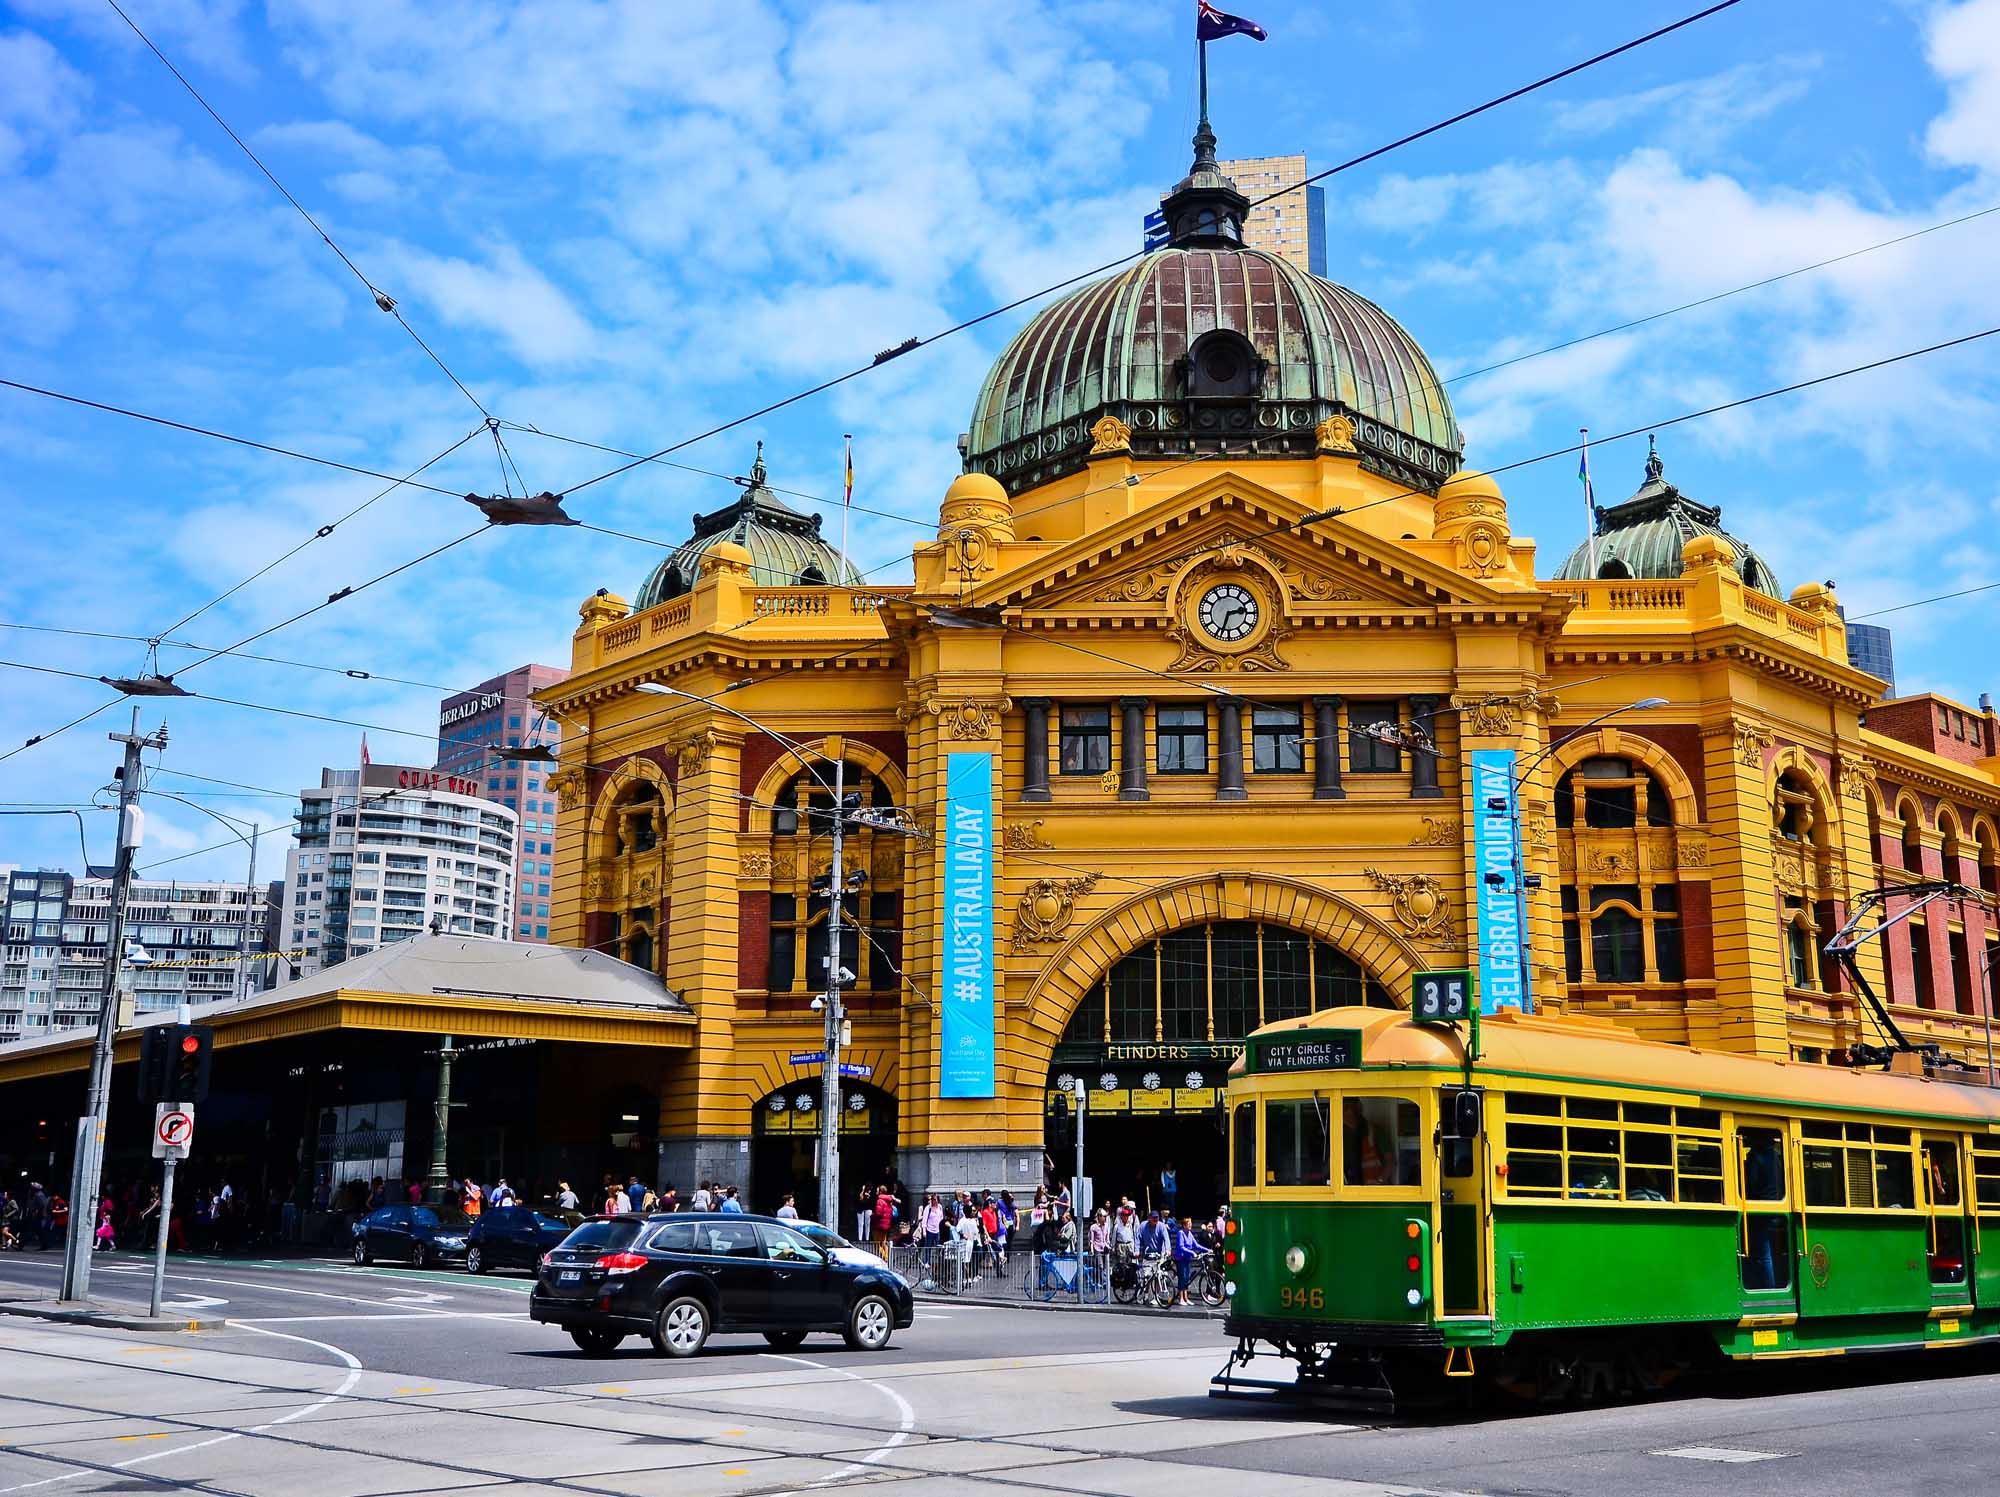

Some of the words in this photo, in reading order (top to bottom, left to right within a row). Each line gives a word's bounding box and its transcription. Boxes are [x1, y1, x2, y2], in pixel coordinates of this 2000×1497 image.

[481, 690, 502, 711] SUN
[399, 770, 440, 790] QUAY
[448, 776, 478, 797] WEST
[1102, 774, 1117, 783] CUT
[1103, 784, 1118, 793] OFF
[1483, 817, 1513, 874] YOUR
[953, 804, 985, 1003] #AUSTRALIADAY
[1423, 981, 1463, 1014] 35
[1108, 1045, 1189, 1060] FLINDERS
[1210, 1045, 1246, 1059] STR
[1267, 1057, 1282, 1067] VIA
[1286, 1055, 1330, 1066] FLINDERS
[1334, 1054, 1346, 1064] ST
[1270, 1046, 1292, 1057] CITY
[1297, 1044, 1332, 1055] CIRCLE
[1281, 1287, 1325, 1310] 946
